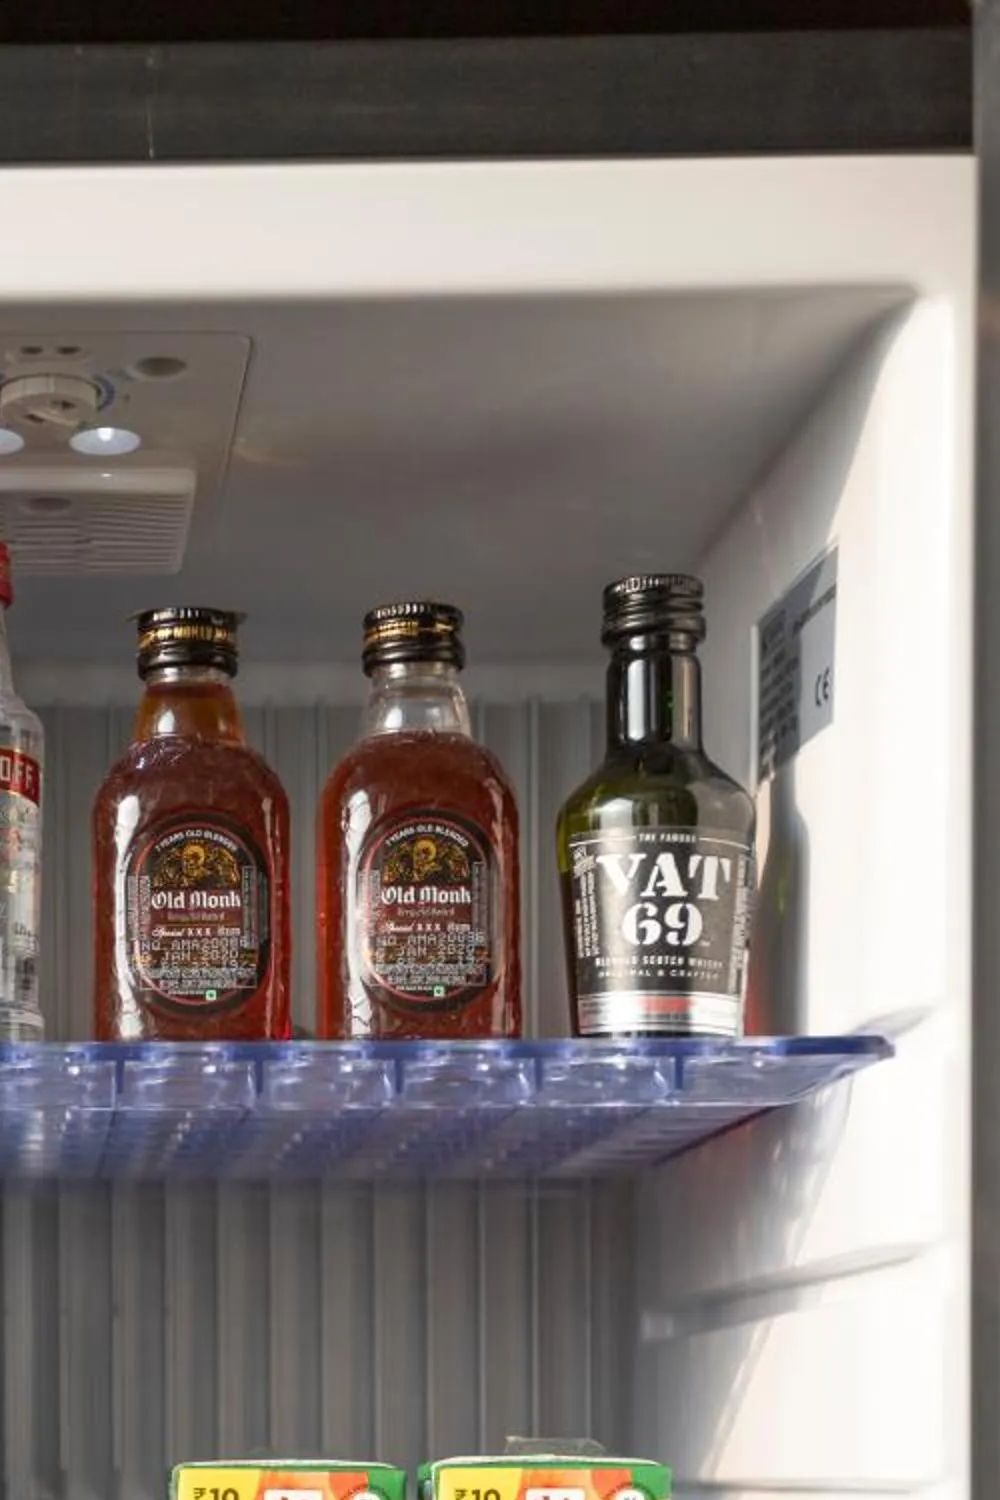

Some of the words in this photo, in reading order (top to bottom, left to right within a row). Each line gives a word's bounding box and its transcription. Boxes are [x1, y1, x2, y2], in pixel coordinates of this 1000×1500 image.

[596, 852, 731, 901] VAT
[151, 890, 186, 910] Old
[190, 889, 241, 909] Monk
[381, 886, 416, 906] Old
[420, 886, 472, 905] Monk
[620, 902, 703, 947] 69
